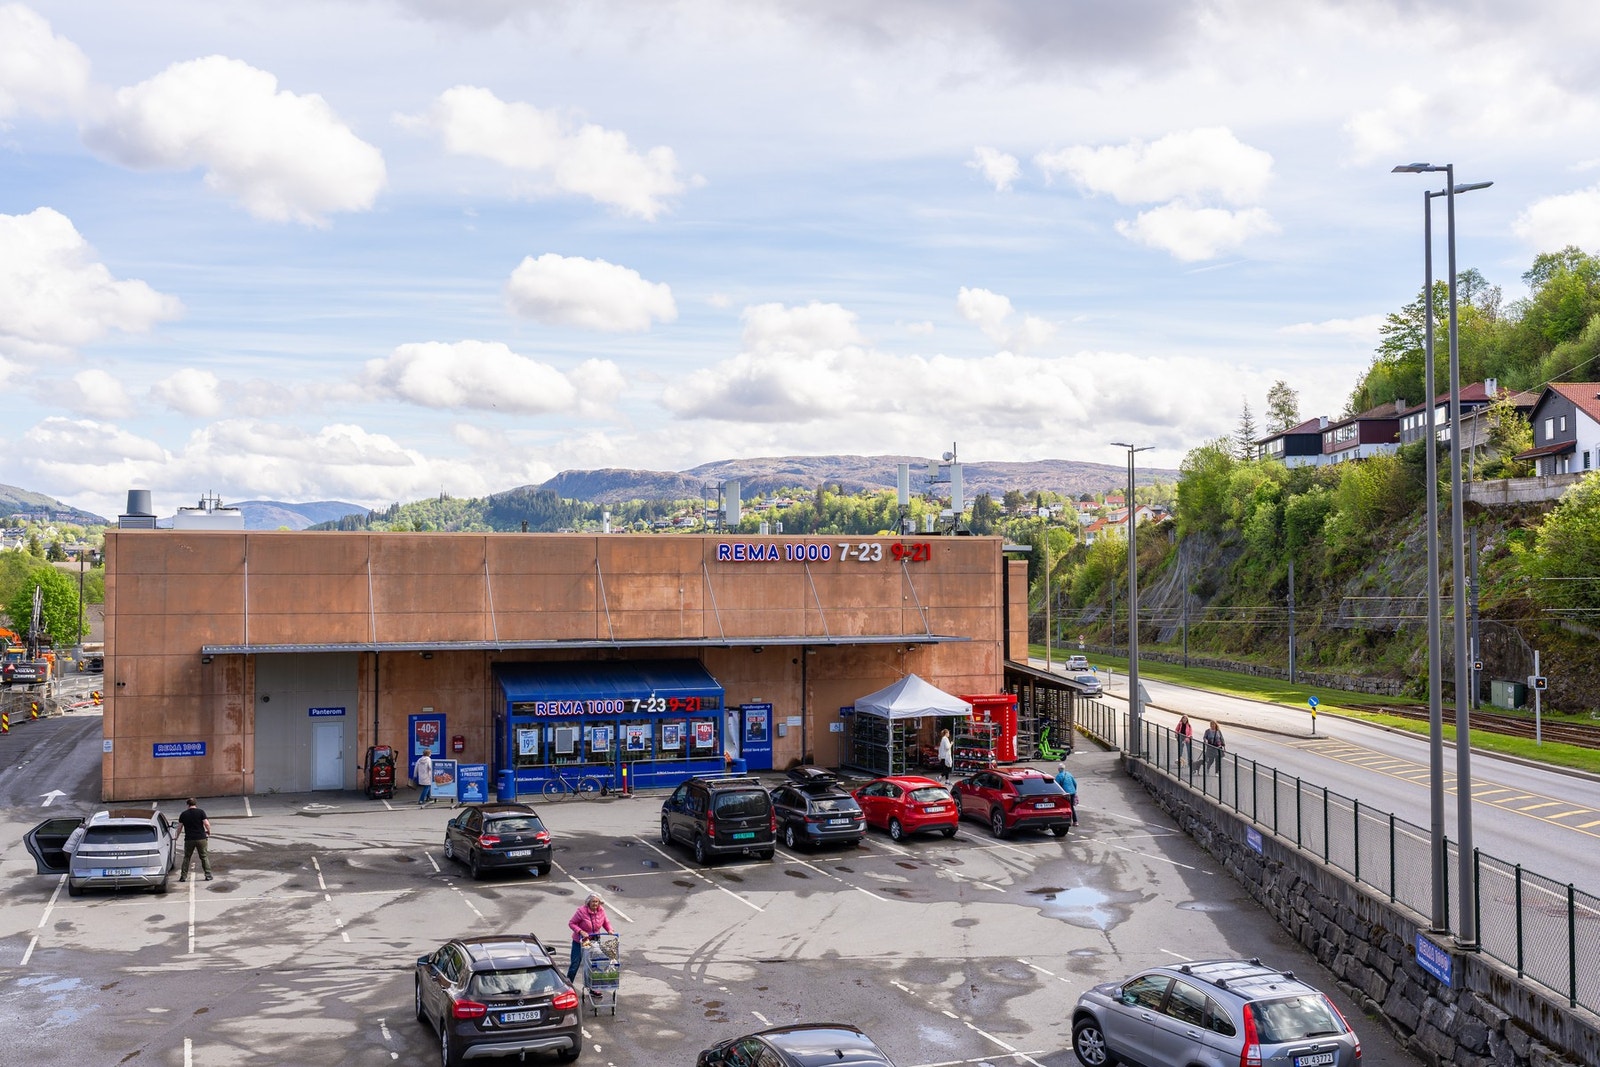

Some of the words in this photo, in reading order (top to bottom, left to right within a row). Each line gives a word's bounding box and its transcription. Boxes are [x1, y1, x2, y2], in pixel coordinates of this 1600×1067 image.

[718, 543, 780, 561] REMA
[785, 543, 831, 561] 1000
[838, 543, 883, 562] 7-23
[891, 543, 931, 561] 9-21
[535, 701, 584, 715] REMA
[587, 700, 624, 714] 1000
[632, 698, 666, 713] 7-23
[669, 697, 700, 712] 9-21
[417, 723, 437, 733] -40%
[183, 743, 201, 751] 1000
[1419, 938, 1435, 962] REMA
[1435, 950, 1448, 971] 1000
[518, 1011, 539, 1020] 12689
[1300, 1057, 1309, 1066] SU
[1311, 1054, 1331, 1064] 43772
